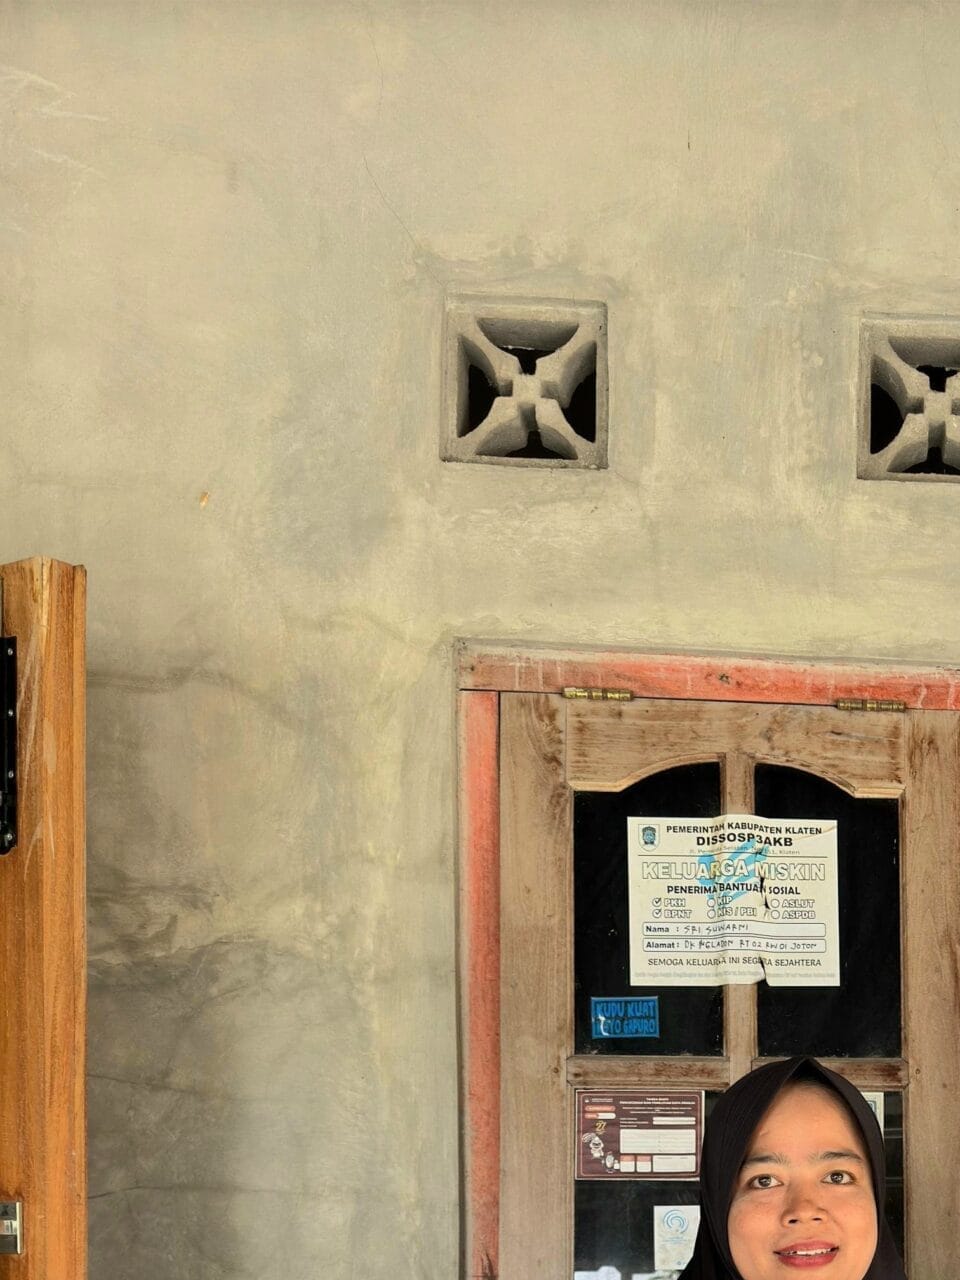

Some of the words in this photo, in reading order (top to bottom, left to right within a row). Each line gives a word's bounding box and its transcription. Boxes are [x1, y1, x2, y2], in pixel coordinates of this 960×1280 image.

[666, 823, 725, 834] PEMERINTAH
[727, 822, 782, 834] KABUPATEN
[785, 827, 822, 835] KLATEN
[696, 832, 793, 847] DISSOSP3AKB
[642, 859, 749, 880] KELUARGA
[755, 862, 826, 881] MISKIN
[667, 885, 718, 895] PENERIMA
[719, 882, 766, 894] BANTUAN
[768, 886, 801, 895] SOSIAL
[664, 898, 686, 907] PKH
[782, 899, 815, 908] ASLUT
[664, 909, 692, 919] BPNT
[645, 925, 670, 933] Nama
[648, 958, 684, 966] SEMOGA
[728, 956, 740, 964] INI
[775, 959, 822, 967] SEJAHTERA
